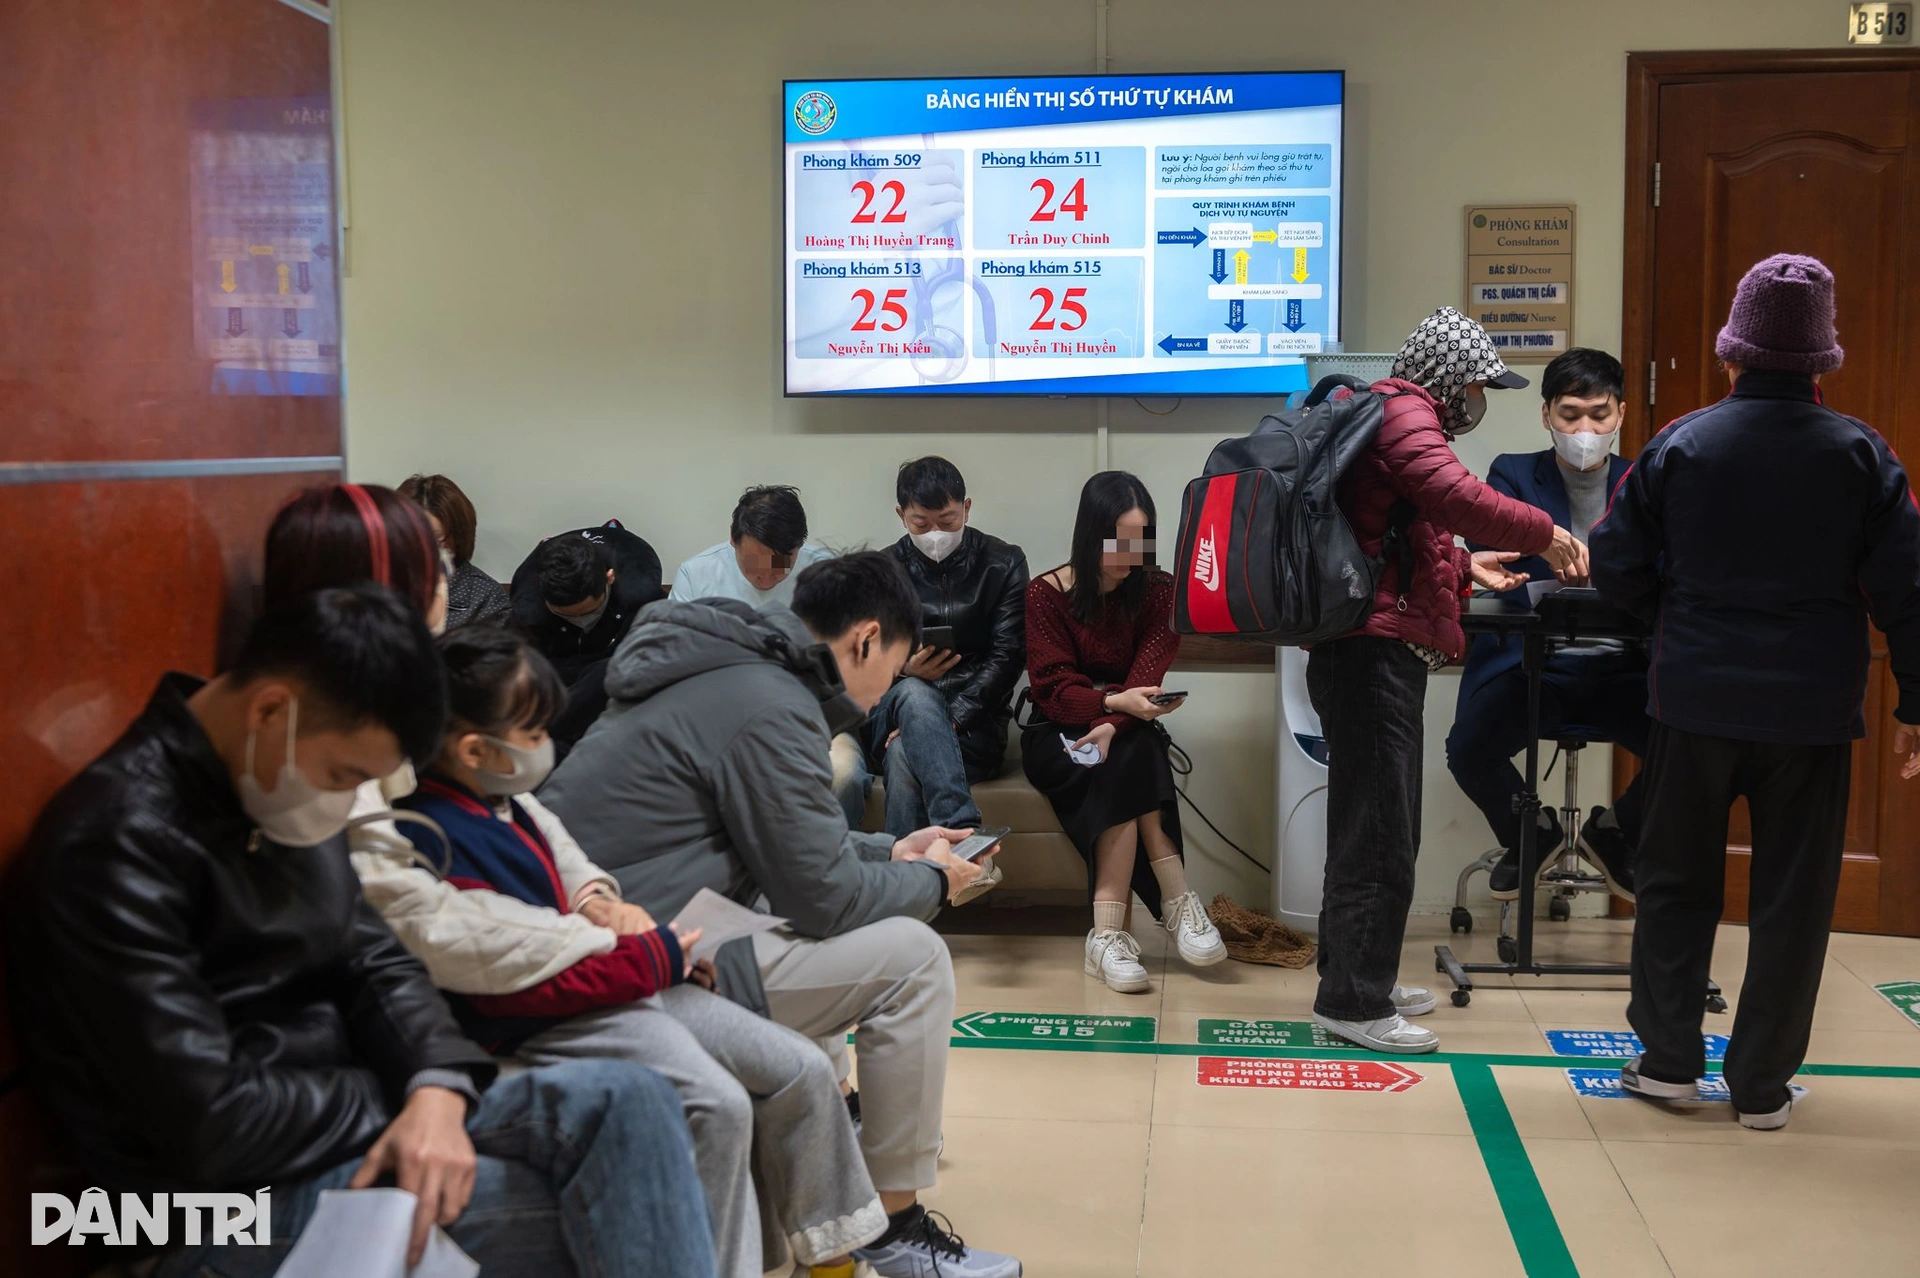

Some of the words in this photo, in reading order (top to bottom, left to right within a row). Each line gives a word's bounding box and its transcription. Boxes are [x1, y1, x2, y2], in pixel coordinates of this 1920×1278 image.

[1857, 12, 1867, 35] B
[1874, 12, 1906, 35] 513
[926, 89, 981, 109] BẢNG
[985, 87, 1030, 108] HIỂN
[1033, 91, 1064, 111] THỊ
[1069, 86, 1095, 107] SỐ
[1098, 87, 1140, 106] THỨ
[1143, 88, 1171, 109] TỰ
[1174, 86, 1234, 105] KHÁM
[803, 154, 846, 169] Phòng
[851, 153, 889, 167] khám
[894, 154, 921, 166] 509
[982, 152, 1025, 167] Phòng
[1030, 151, 1069, 164] khám
[1074, 152, 1100, 164] 511
[1183, 154, 1192, 163] ý:
[1195, 153, 1221, 163] Người
[1224, 152, 1244, 162] bệnh
[1246, 152, 1259, 160] vui
[1261, 152, 1280, 162] lòng
[1162, 164, 1181, 174] ngồi
[1183, 163, 1198, 172] chờ
[1200, 163, 1213, 172] loa
[1215, 164, 1229, 174] gọi
[1231, 162, 1255, 172] khám
[1257, 163, 1275, 171] theo
[1278, 162, 1287, 171] số
[1289, 162, 1303, 171] thứ
[1162, 176, 1172, 184] tại
[1174, 174, 1202, 185] phòng
[1204, 174, 1227, 182] khám
[1229, 174, 1243, 184] ghi
[1245, 174, 1260, 182] trên
[1263, 173, 1287, 184] phiếu
[850, 180, 907, 223] 22
[1029, 178, 1088, 221] 24
[1215, 201, 1240, 209] TRÌNH
[1242, 201, 1270, 209] KHÁM
[1272, 201, 1295, 209] BỆNH
[1200, 210, 1220, 218] DỊCH
[1223, 210, 1235, 218] VỤ
[1237, 210, 1248, 218] TỰ
[1251, 209, 1288, 218] NGUYỆN
[1490, 218, 1530, 231] PHÒNG
[1534, 217, 1568, 230] KHÁM
[805, 235, 844, 249] Hoàng
[848, 235, 869, 248] Thị
[873, 232, 912, 248] Huyền
[916, 235, 955, 248] Trang
[1008, 230, 1038, 244] Trần
[1043, 233, 1067, 247] Duy
[1072, 233, 1110, 244] Chinh
[1497, 237, 1559, 247] Consultation
[804, 262, 846, 278] Phòng
[851, 262, 889, 275] khám
[894, 263, 921, 275] 513
[982, 261, 1025, 277] Phòng
[1030, 260, 1068, 273] khám
[1074, 261, 1101, 273] 515
[1489, 264, 1505, 275] BÁC
[1520, 265, 1552, 275] Doctor
[1482, 288, 1499, 300] PGS.
[1501, 285, 1526, 300] QUÁCH
[1528, 287, 1539, 300] THỊ
[851, 289, 908, 331] 25
[1029, 287, 1087, 331] 25
[1531, 313, 1556, 322] Nurse
[828, 340, 873, 356] Nguyễn
[878, 343, 898, 356] Thị
[903, 340, 930, 353] Kiều
[1000, 339, 1046, 355] Nguyễn
[1051, 342, 1072, 355] Thị
[1077, 339, 1116, 355] Huyền
[1490, 335, 1508, 349] HẠM
[1511, 335, 1521, 349] THỊ
[1195, 537, 1212, 583] NIKE
[1000, 1016, 1067, 1025] PHÒNG
[1031, 1025, 1095, 1036] 515
[1213, 1029, 1290, 1037] PHÒNG
[1227, 1060, 1294, 1069] PHÒNG
[1227, 1068, 1295, 1077] PHÒNG
[1352, 1081, 1381, 1089] XN
